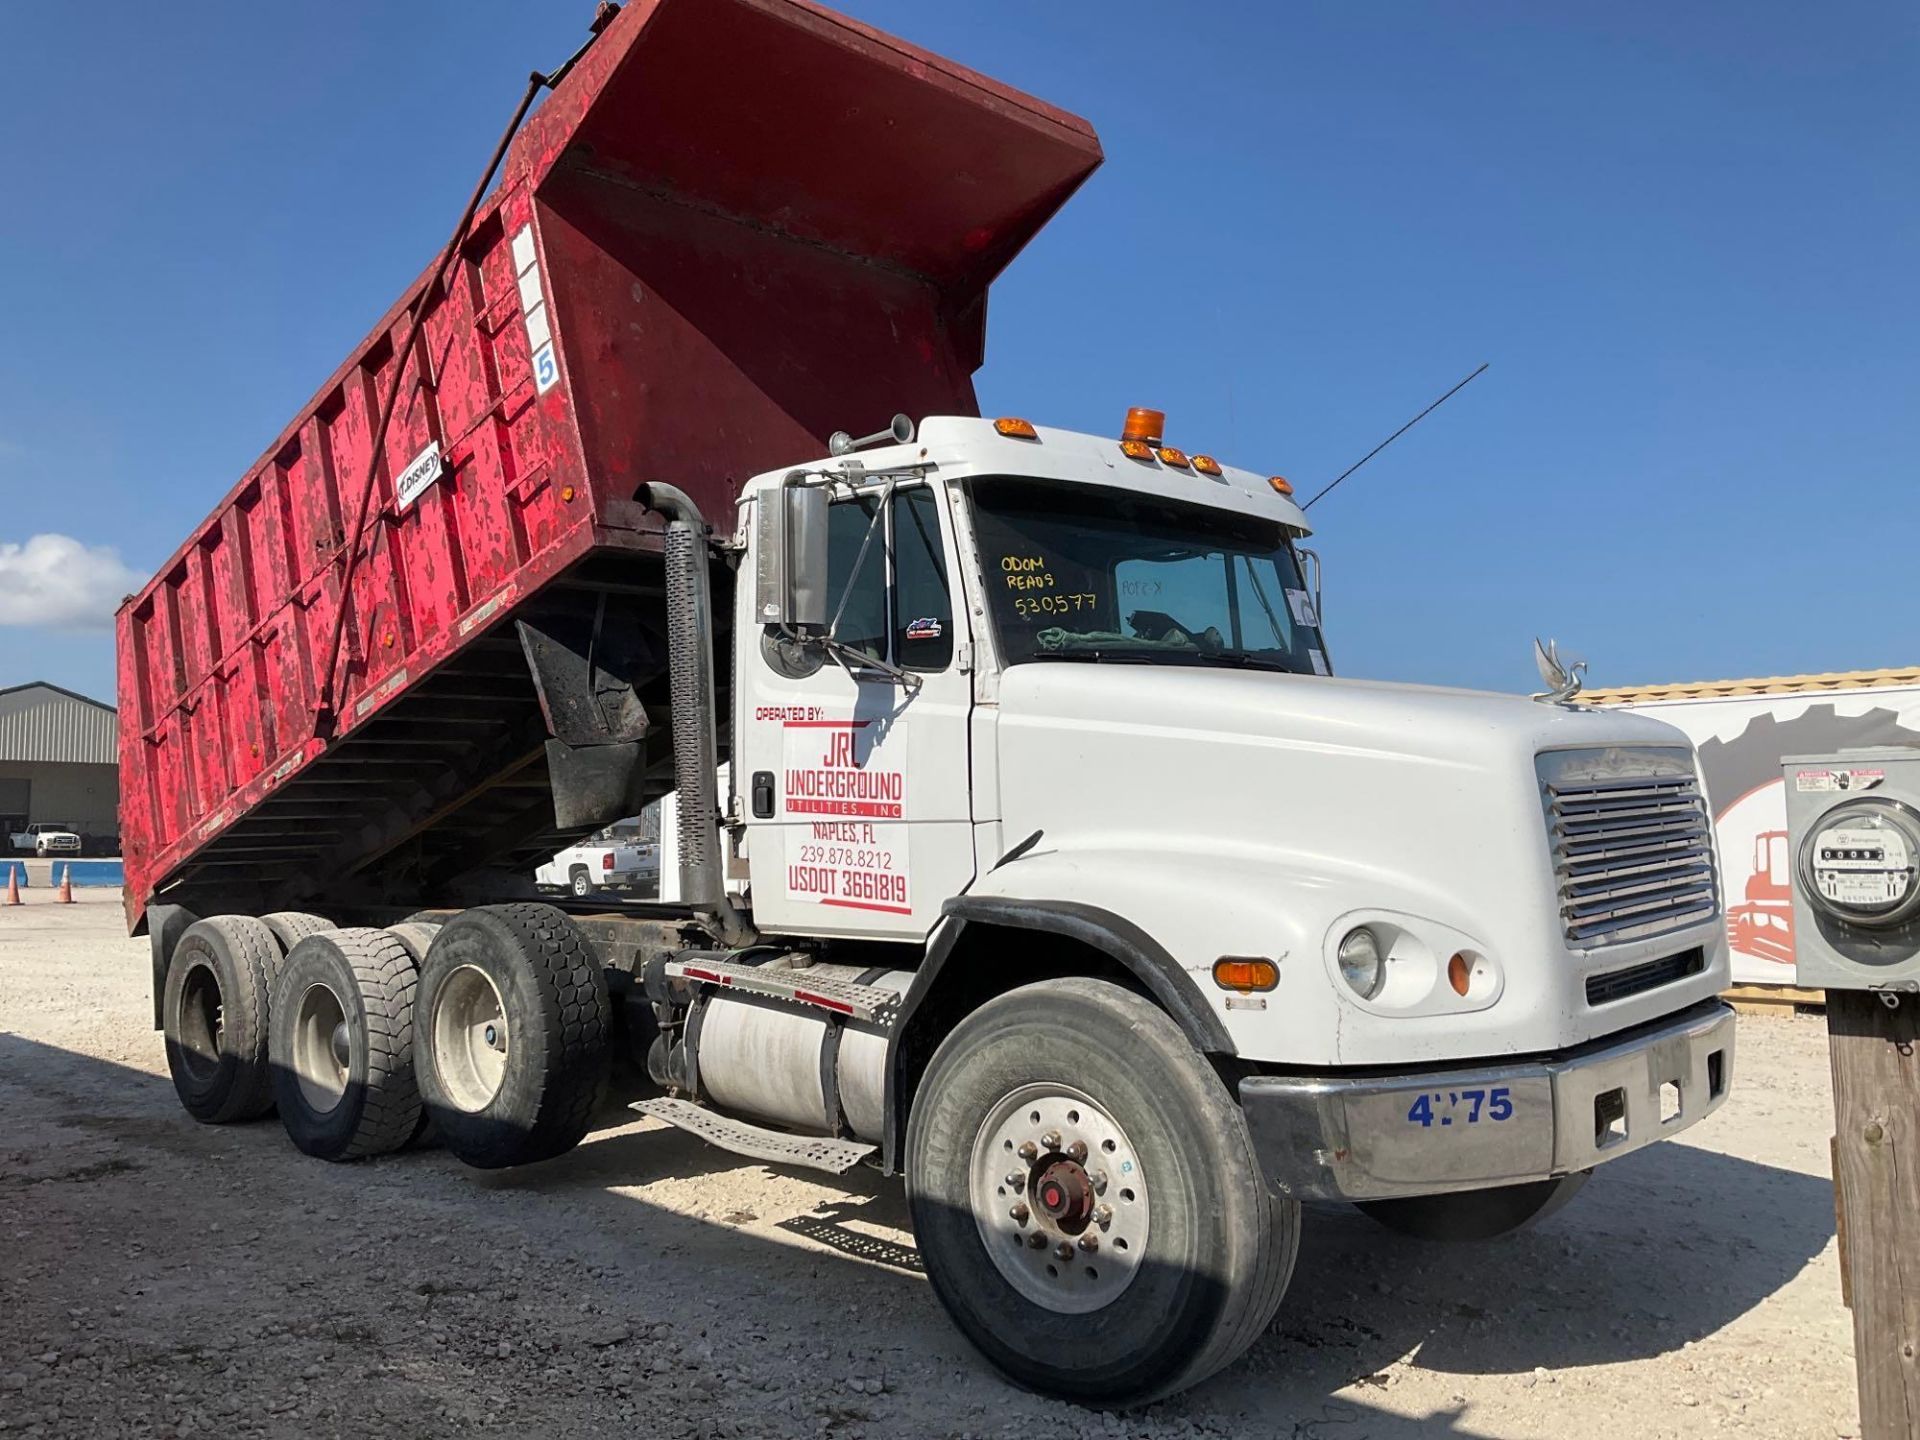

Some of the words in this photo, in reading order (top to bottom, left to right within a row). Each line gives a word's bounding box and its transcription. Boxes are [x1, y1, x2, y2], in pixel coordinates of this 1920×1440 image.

[538, 351, 554, 386] 5
[1001, 556, 1045, 572] ODOM
[1007, 573, 1054, 590] READS
[1015, 594, 1096, 615] 530,577
[756, 707, 804, 721] OPERATED
[807, 707, 824, 721] BY:
[823, 732, 860, 768] JRL
[785, 769, 902, 801] UNDERGROUND
[811, 821, 860, 844] NAPLES,
[863, 823, 876, 844] FL
[801, 845, 892, 870] 239.878.8212
[789, 865, 837, 895] USDOT
[842, 870, 906, 902] 3661819
